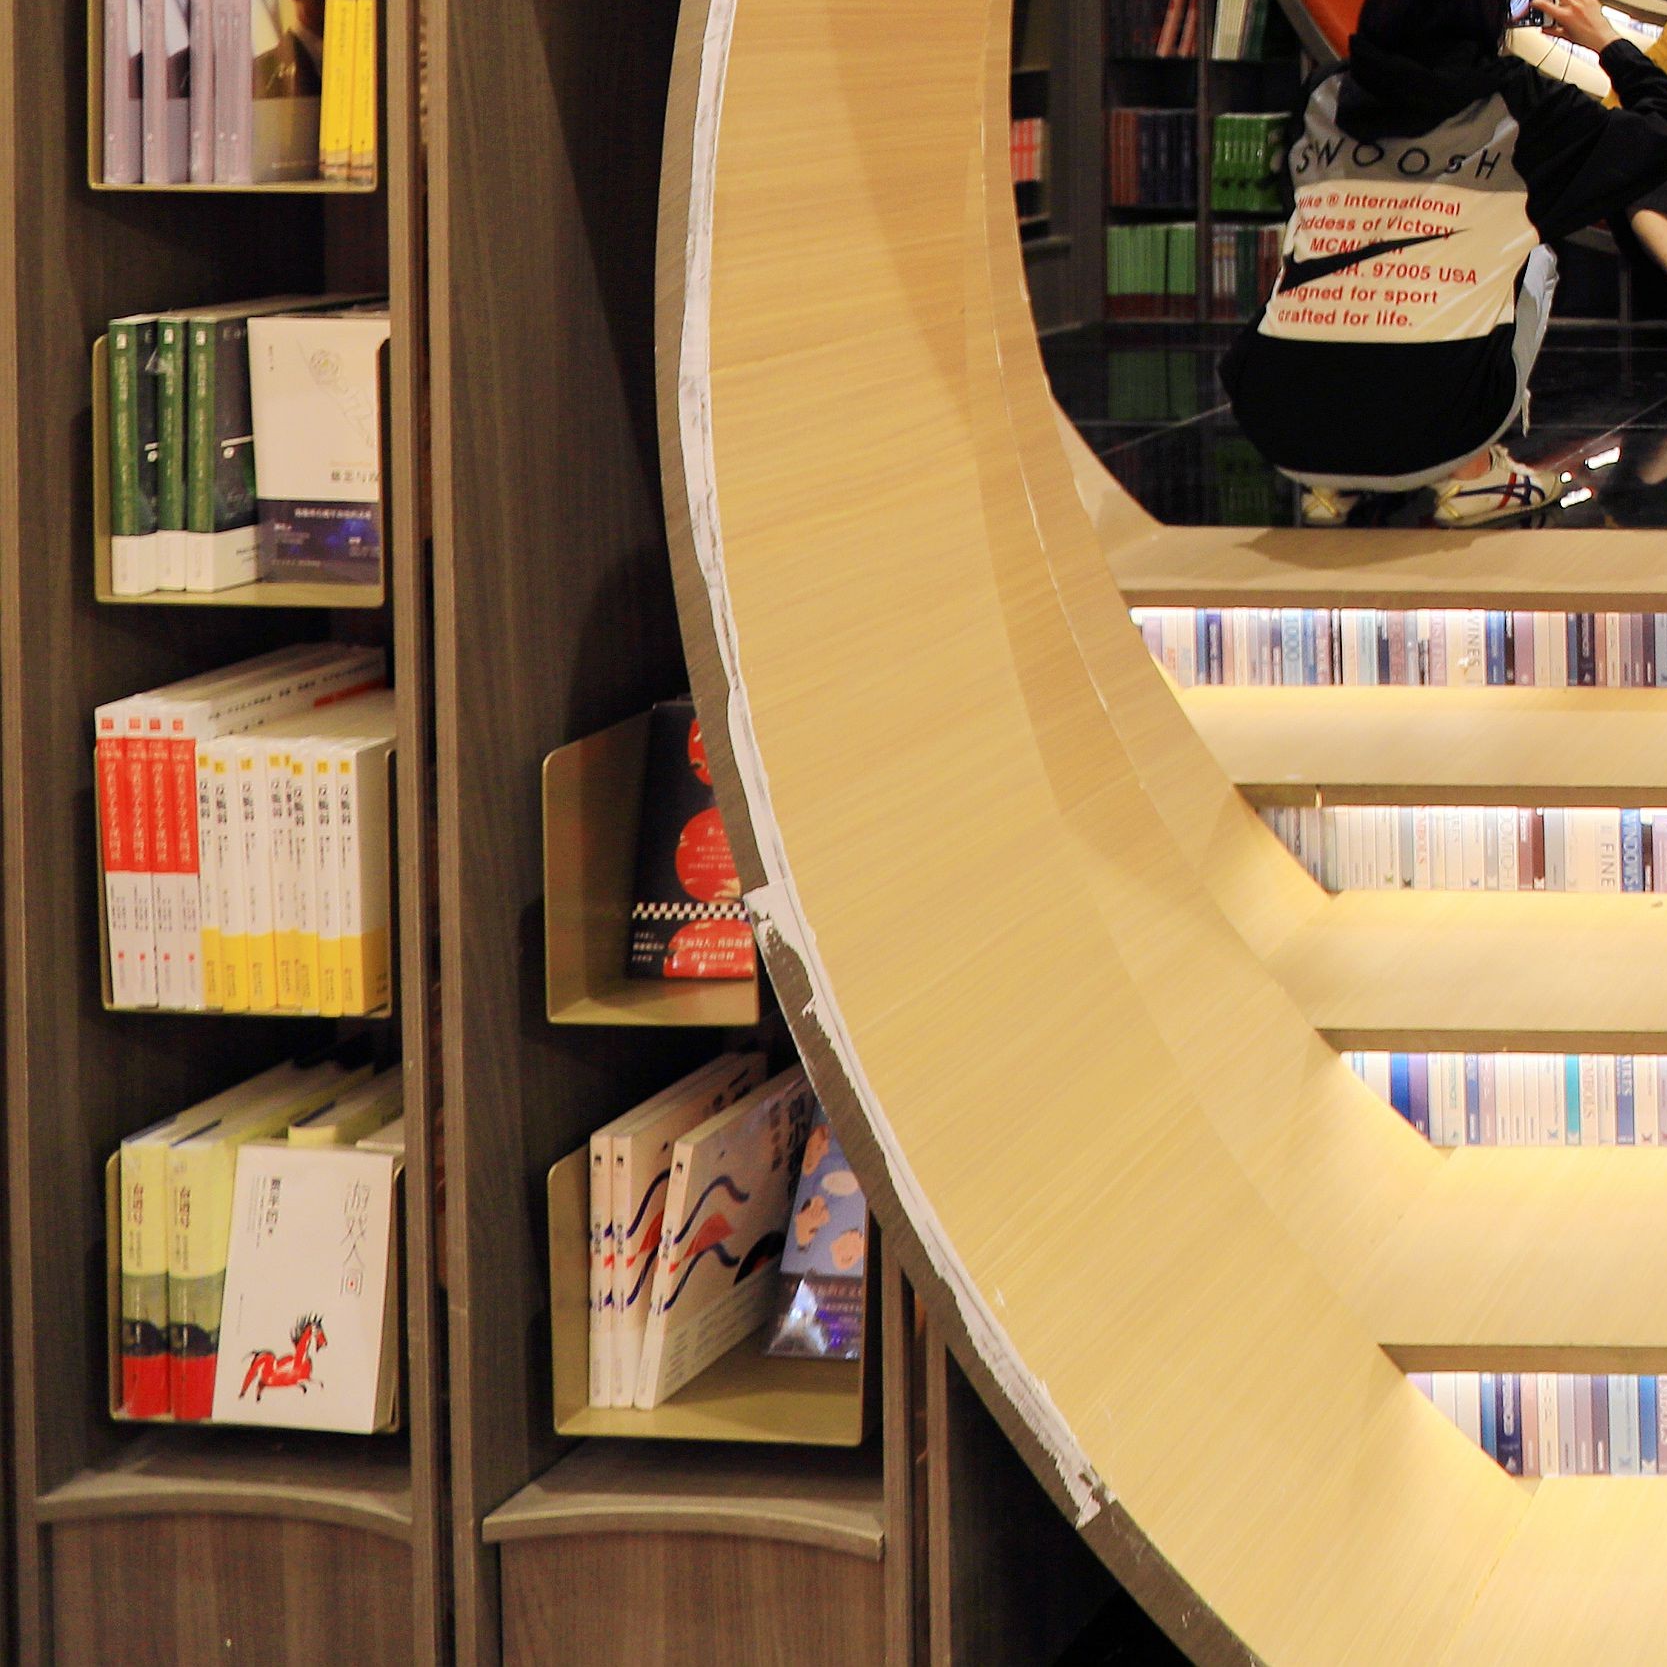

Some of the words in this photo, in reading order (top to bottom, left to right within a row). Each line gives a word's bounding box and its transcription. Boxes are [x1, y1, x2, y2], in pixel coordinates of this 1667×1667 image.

[1294, 137, 1502, 179] SWOOSH
[1343, 193, 1461, 217] International
[1296, 216, 1356, 232] oddess
[1362, 217, 1381, 232] of
[1386, 216, 1454, 238] Victory
[1372, 262, 1431, 281] 97005
[1438, 267, 1478, 285] USA
[1350, 285, 1376, 301] for
[1384, 287, 1438, 306] sport
[1277, 309, 1336, 326] crafted
[1343, 309, 1370, 326] for
[1376, 309, 1413, 327] life.
